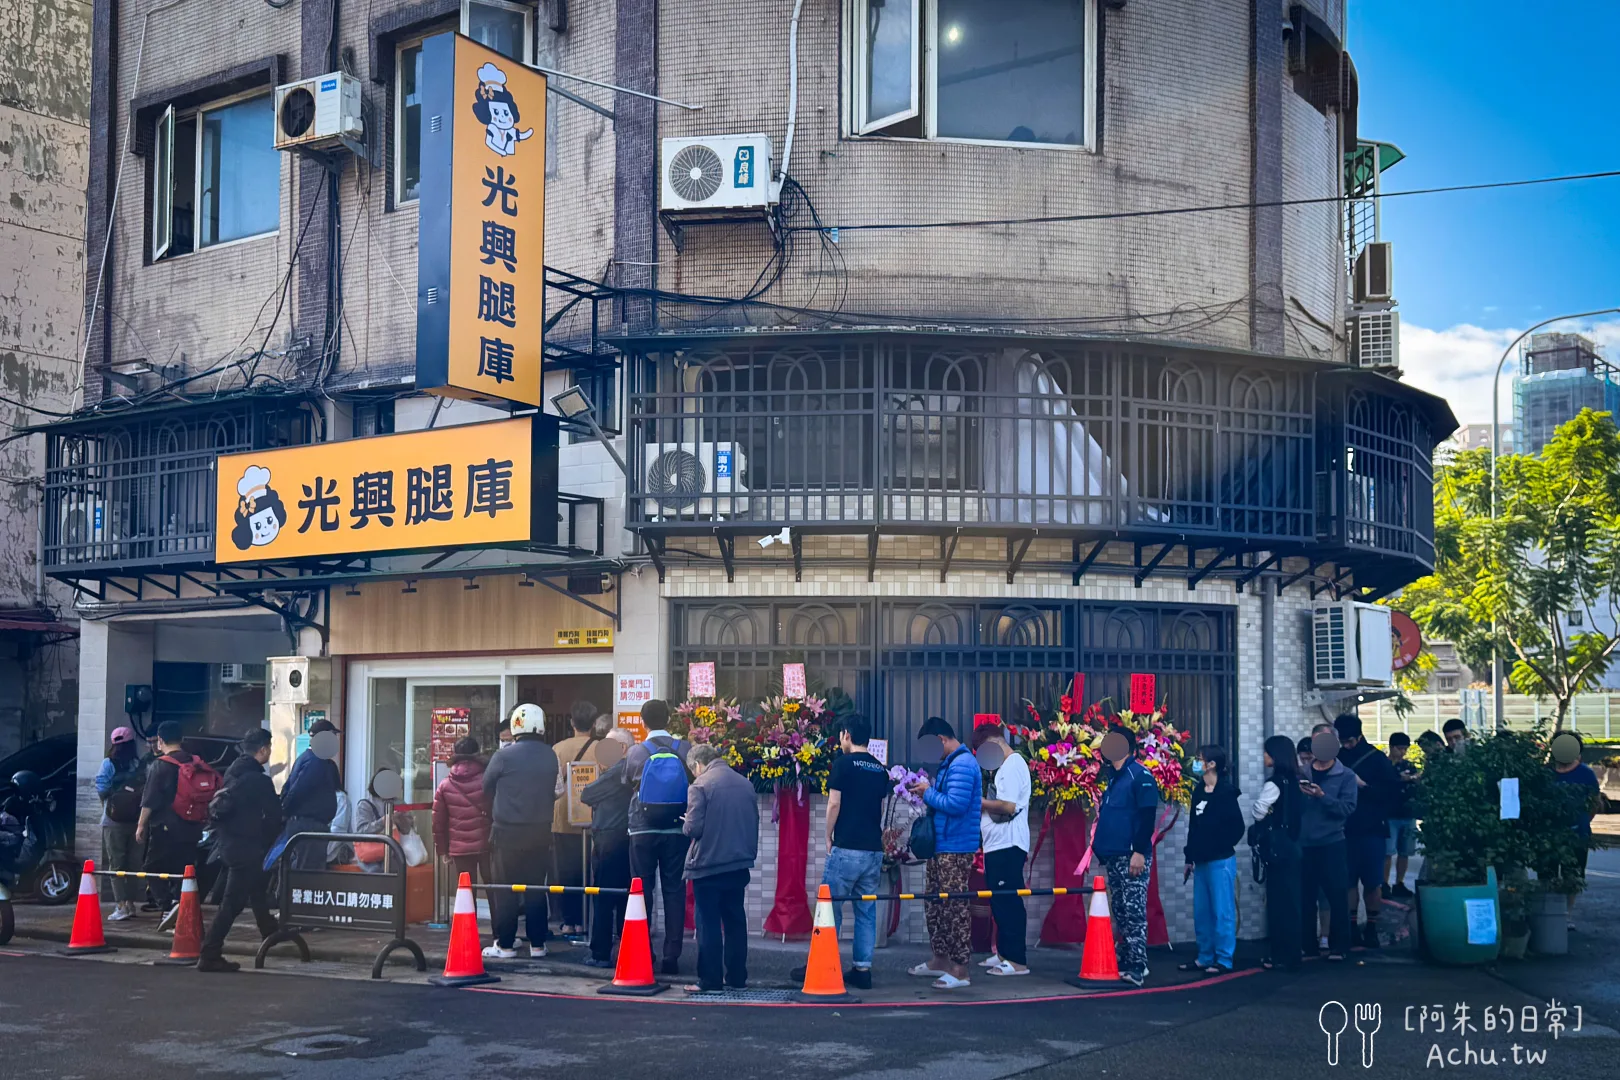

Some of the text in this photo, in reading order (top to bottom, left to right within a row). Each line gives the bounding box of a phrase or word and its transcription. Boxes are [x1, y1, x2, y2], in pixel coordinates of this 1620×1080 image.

[477, 165, 519, 384] 光興腿庫
[297, 458, 514, 534] 光興腿庫
[620, 679, 651, 689] 營業門口
[620, 691, 651, 701] 請勿停車
[292, 888, 394, 910] 營業出入口請勿停車
